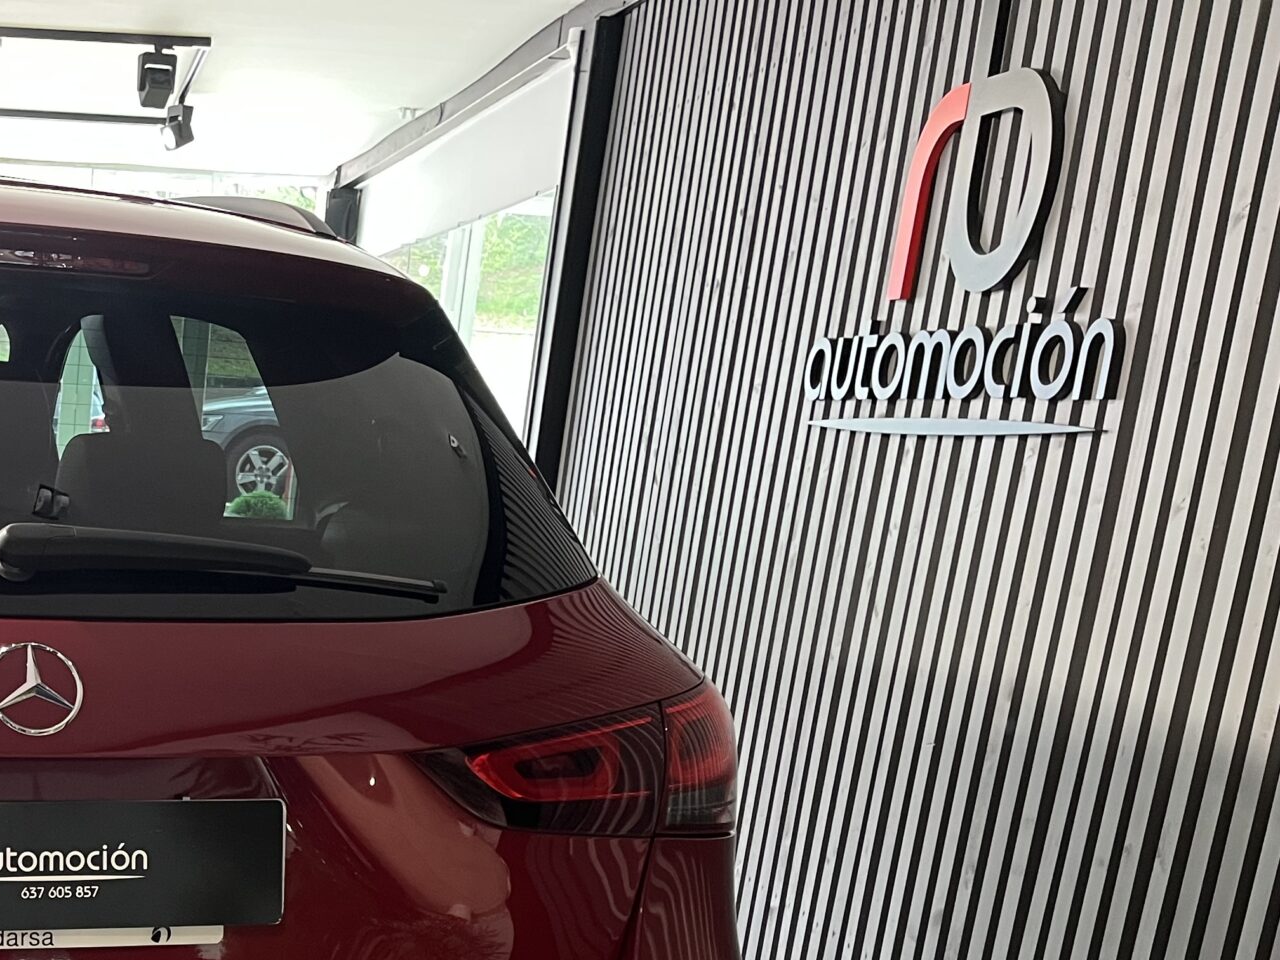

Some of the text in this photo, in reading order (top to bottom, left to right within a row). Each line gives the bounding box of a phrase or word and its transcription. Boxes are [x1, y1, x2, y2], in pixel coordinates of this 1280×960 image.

[803, 287, 1119, 401] automoción
[20, 885, 99, 899] 637 605 857
